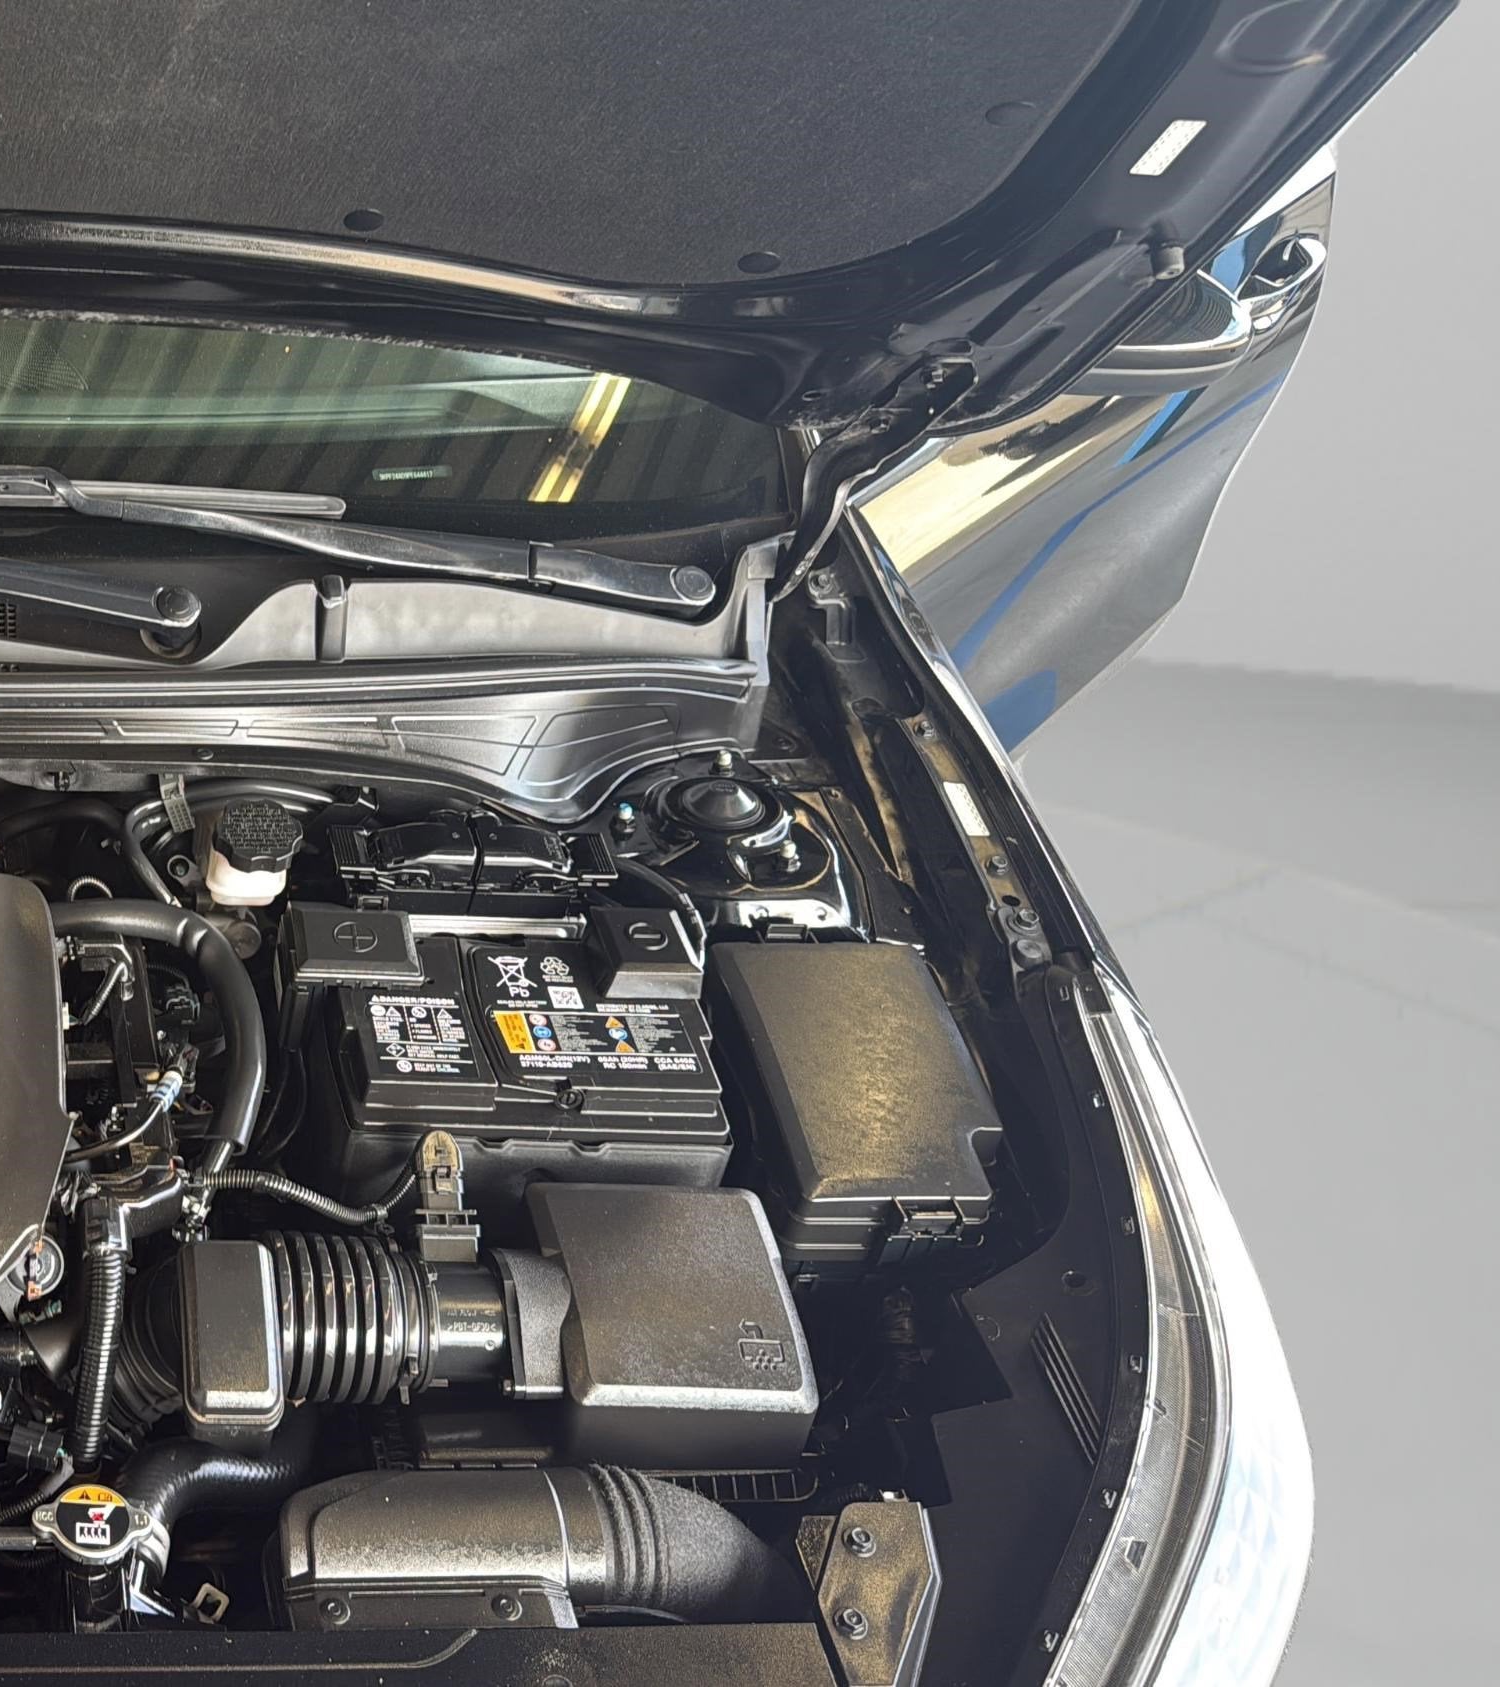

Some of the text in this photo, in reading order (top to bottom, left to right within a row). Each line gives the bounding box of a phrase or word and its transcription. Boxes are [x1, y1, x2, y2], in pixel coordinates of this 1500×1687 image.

[509, 986, 530, 997] Pb
[380, 995, 455, 1005] DANGER/POISON
[134, 1514, 148, 1525] 1.1
